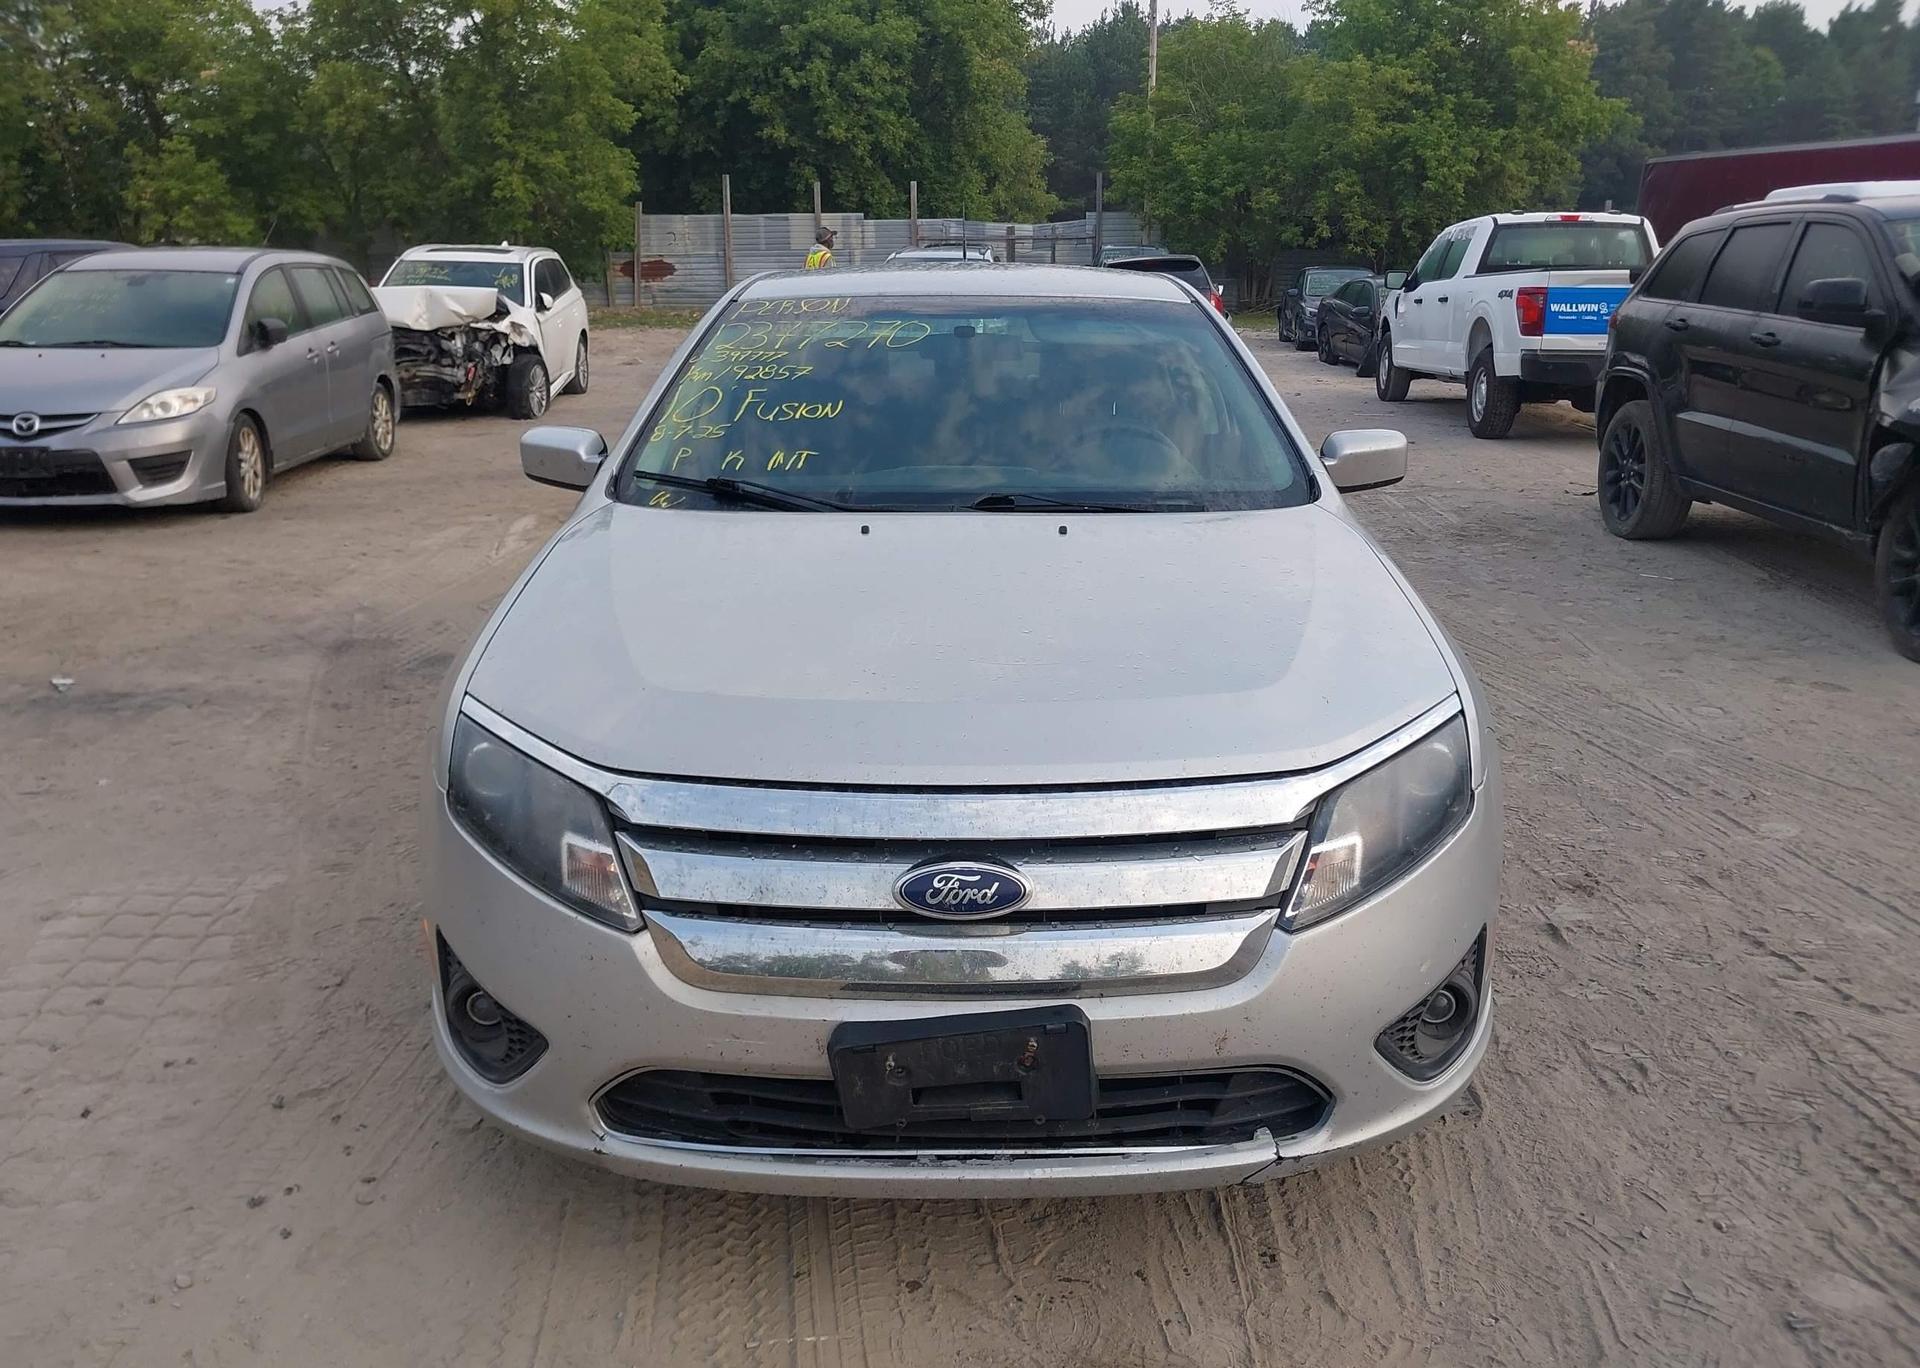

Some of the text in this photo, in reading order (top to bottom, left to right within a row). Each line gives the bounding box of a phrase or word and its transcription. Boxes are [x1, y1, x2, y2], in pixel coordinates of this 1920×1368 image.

[1550, 303, 1599, 312] WALLWIN
[672, 447, 692, 471] P
[925, 873, 1000, 905] Ford
